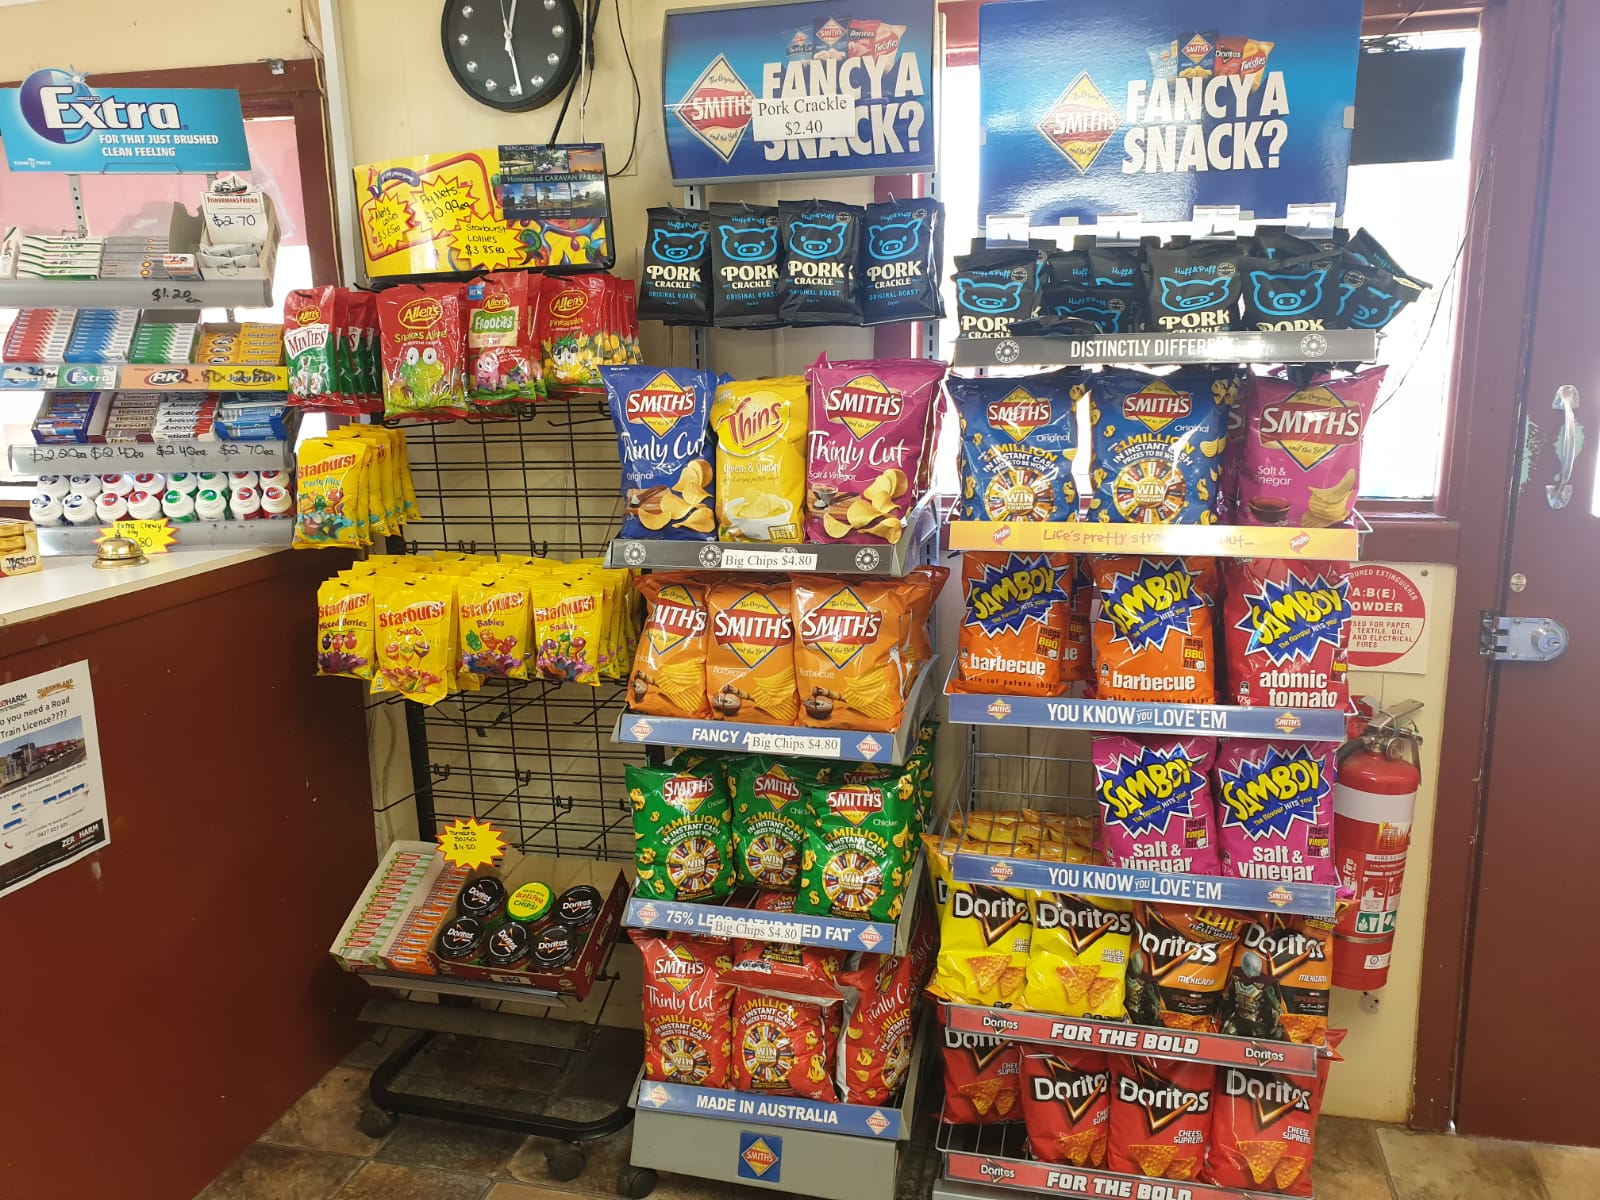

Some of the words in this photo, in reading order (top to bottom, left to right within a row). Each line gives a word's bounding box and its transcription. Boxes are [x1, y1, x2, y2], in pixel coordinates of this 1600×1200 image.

[1214, 48, 1241, 59] Doritos
[763, 54, 890, 99] FANCY
[894, 52, 924, 97] A
[1126, 75, 1256, 123] FANCY
[1259, 71, 1290, 117] A
[39, 86, 182, 130] Extra
[691, 91, 753, 122] SMITH'S
[758, 101, 790, 117] Pork
[793, 96, 848, 114] Crackle
[785, 119, 823, 136] $2.40
[100, 134, 119, 145] FOR
[121, 134, 145, 145] THAT
[149, 134, 171, 145] JUST
[174, 135, 219, 145] BRUSHED
[1121, 119, 1290, 175] SNACK?
[102, 146, 134, 157] CLEAN
[135, 146, 176, 157] FEELING
[544, 174, 577, 182] CARAVAN
[647, 265, 701, 281] PORK
[721, 264, 779, 281] PORK
[788, 261, 846, 278] PORK
[866, 261, 922, 281] PORK
[654, 280, 692, 289] CRACKLE
[732, 280, 771, 289] CRACKLE
[794, 277, 834, 286] CRACKLE
[874, 278, 912, 289] CRACKLE
[553, 296, 585, 311] Allen's
[402, 305, 439, 323] Allen's
[1158, 312, 1230, 328] PORK
[287, 331, 326, 356] MINTIES
[1071, 339, 1151, 358] DISTINCTLY
[627, 392, 694, 413] SMITH'S
[827, 389, 902, 416] SMITH'S
[1124, 396, 1192, 414] SMITH'S
[720, 397, 782, 445] Thins
[988, 404, 1051, 423] SMITH'S
[1260, 407, 1360, 436] SMITH'S
[1036, 433, 1072, 443] Original
[808, 430, 864, 472] Thinly
[868, 436, 911, 468] Cut
[297, 454, 357, 478] Starburst
[723, 463, 746, 473] Cheese
[1257, 466, 1277, 475] Salt
[1279, 466, 1287, 475] &
[303, 478, 323, 488] Party
[626, 472, 654, 480] Original
[771, 529, 795, 540] TASTY
[1043, 529, 1081, 542] Life's
[1082, 531, 1127, 545] pretty
[725, 554, 745, 569] Big
[747, 554, 779, 569] Chips
[781, 554, 812, 568] $4.80
[973, 566, 1056, 620] SAMBOY
[1375, 569, 1418, 601] EXTINGUISHER
[318, 593, 370, 617] Starburst
[461, 592, 524, 619] Starburst
[536, 596, 596, 622] Starburst
[1105, 570, 1192, 634] SAMBOY
[1352, 601, 1404, 612] OWDER
[342, 618, 368, 628] Berries
[379, 601, 446, 628] Starburst
[476, 618, 505, 628] Babies
[1252, 589, 1342, 645] SAMBOY
[715, 613, 792, 639] SMITH'S
[802, 612, 881, 637] SMITH'S
[1369, 635, 1414, 643] ELECTRICAL
[1184, 648, 1203, 658] BBQ
[970, 653, 1047, 676] barbecue
[1112, 670, 1197, 692] barbecue
[1259, 669, 1329, 688] atomic
[1269, 688, 1338, 708] tomato
[7, 714, 22, 725] you
[24, 704, 44, 717] need
[52, 696, 70, 707] Road
[1047, 703, 1080, 722] YOU
[1082, 705, 1136, 726] KNOW
[1137, 711, 1152, 720] YOU
[1154, 707, 1195, 727] LOVE
[1, 726, 21, 739] Train
[692, 727, 739, 744] FANCY
[752, 736, 774, 750] Big
[775, 737, 805, 751] Chips
[807, 738, 839, 751] $4.80
[1103, 758, 1193, 818] SAMBOY
[1223, 759, 1321, 821] SAMBOY
[828, 792, 882, 808] SMITH'S
[873, 818, 899, 827] Chicken
[1133, 841, 1168, 857] salt
[1171, 844, 1182, 857] &
[1252, 846, 1288, 864] salt
[1292, 850, 1304, 864] &
[1120, 856, 1193, 874] vinegar
[1237, 861, 1315, 882] vinegar
[1048, 866, 1080, 887] YOU
[1082, 870, 1133, 892] KNOW
[1151, 878, 1189, 897] LOVE
[514, 900, 537, 911] CHIPS!
[666, 910, 694, 926] 75%
[1039, 902, 1131, 932] Doritos
[715, 921, 734, 934] Big
[736, 921, 766, 937] Chips
[768, 924, 797, 939] $4.80
[1244, 923, 1325, 958] Doritos
[655, 958, 704, 976] SMITH'S
[646, 984, 686, 1014] Thinly
[689, 988, 716, 1011] Cut
[982, 1016, 1019, 1030] Doritos
[1051, 1022, 1098, 1042] FOR
[1099, 1028, 1139, 1048] THE
[1141, 1035, 1200, 1055] BOLD
[1244, 1047, 1285, 1062] Doritos
[1120, 1077, 1209, 1114] Doritos
[1226, 1069, 1311, 1111] Doritos
[696, 1094, 736, 1112] MADE
[739, 1099, 755, 1113] IN
[757, 1101, 838, 1124] AUSTRALIA
[745, 1149, 774, 1162] SMITH'S
[1046, 1171, 1090, 1193] FOR
[1093, 1177, 1134, 1198] THE
[1136, 1184, 1193, 1200] BOLD
